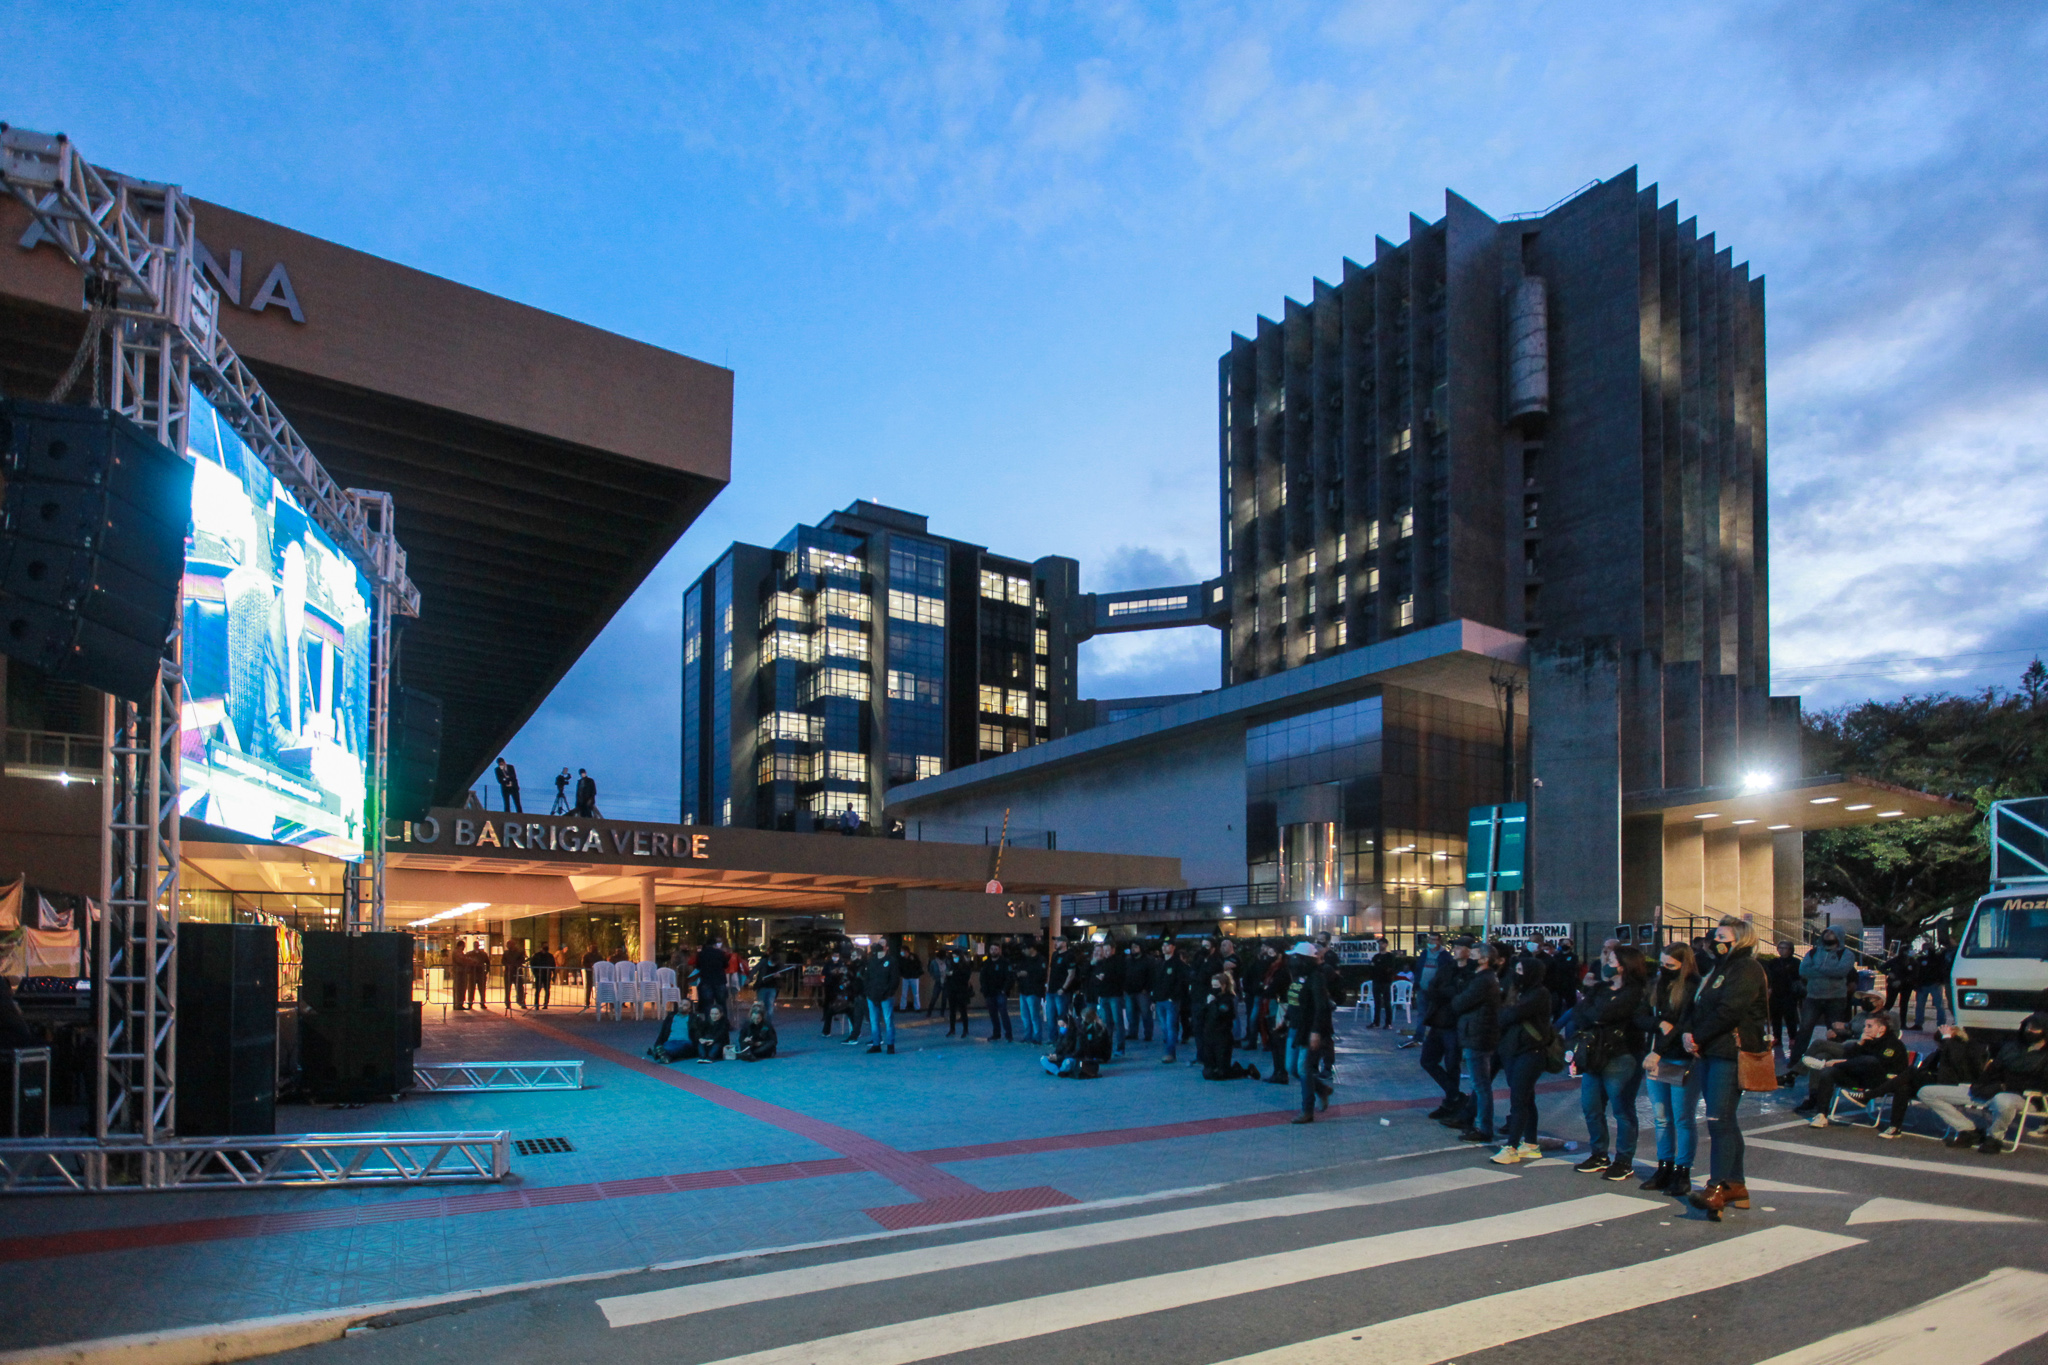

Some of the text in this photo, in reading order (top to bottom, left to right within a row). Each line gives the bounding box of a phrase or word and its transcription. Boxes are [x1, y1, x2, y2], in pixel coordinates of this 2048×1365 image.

[455, 818, 604, 854] BARRIGA
[610, 828, 710, 859] VERDE
[1521, 925, 1567, 937] REFORMA
